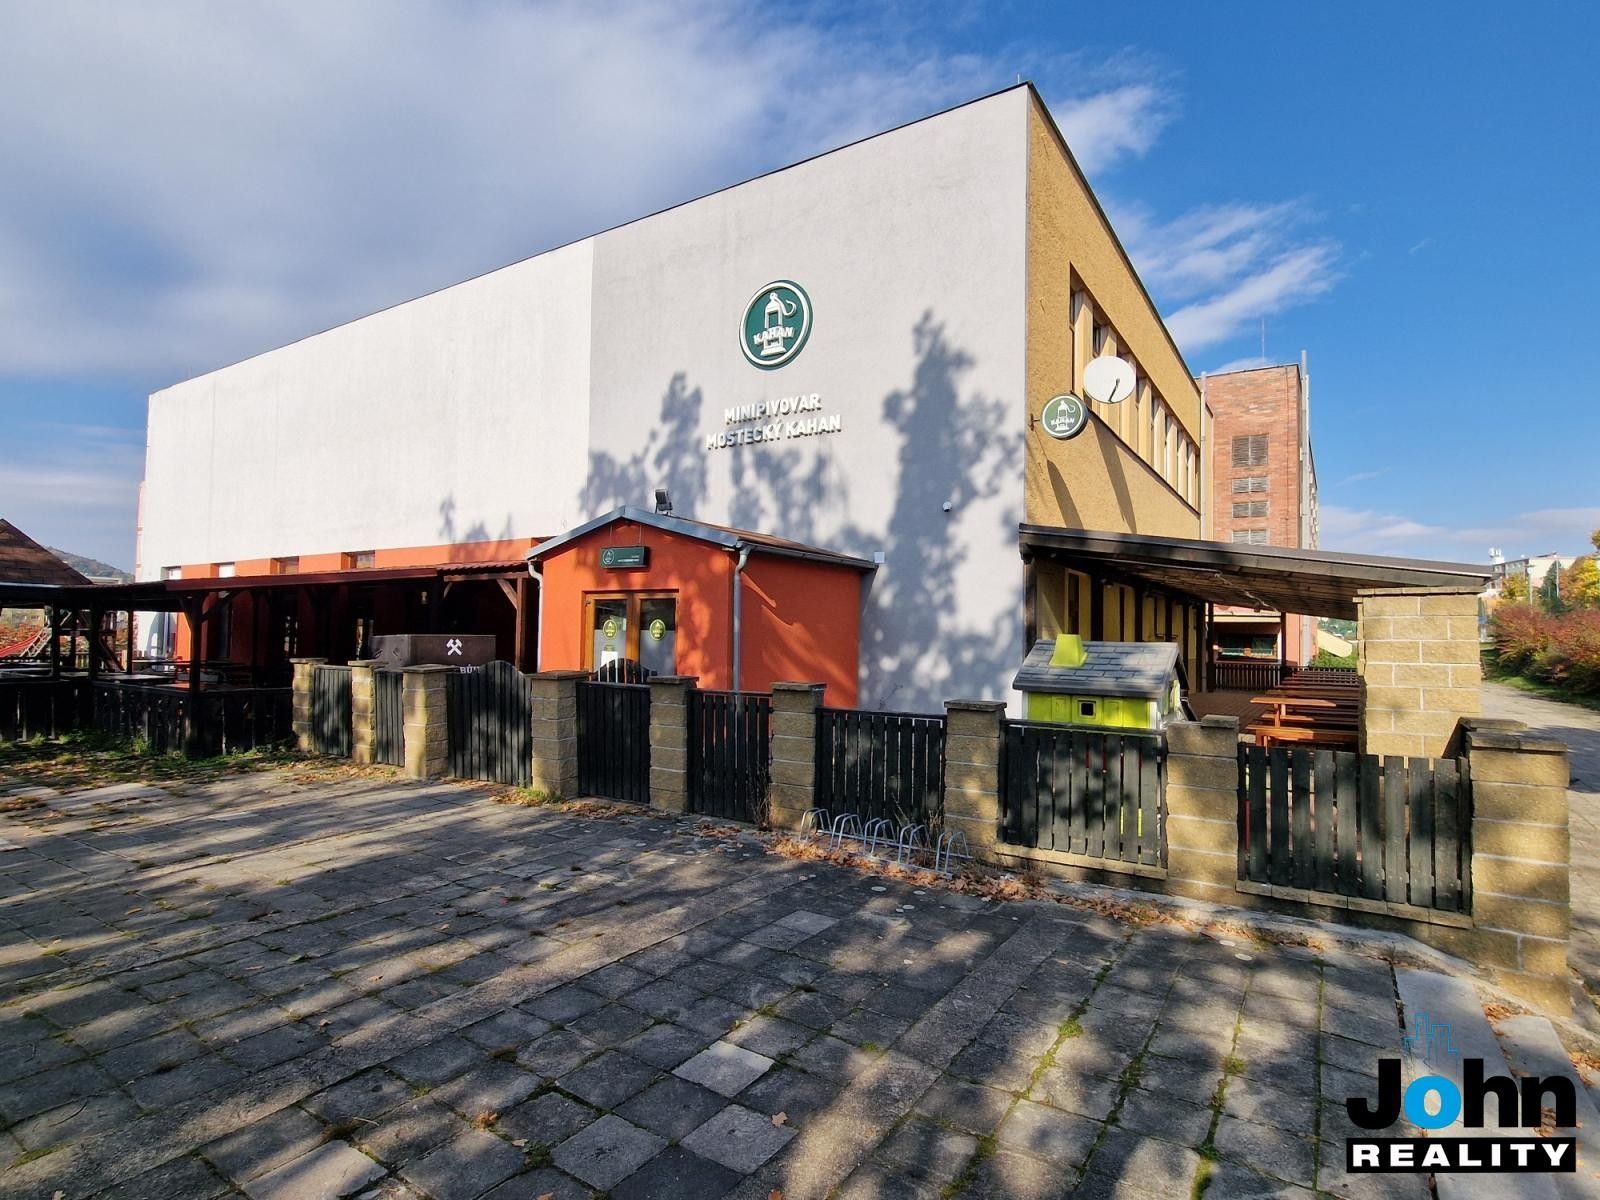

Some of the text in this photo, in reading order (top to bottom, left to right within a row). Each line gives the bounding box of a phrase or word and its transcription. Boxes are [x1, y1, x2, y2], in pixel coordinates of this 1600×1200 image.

[753, 326, 795, 345] KAHAN
[724, 393, 823, 425] MINIPIVOVAR
[705, 415, 842, 450] MOSTECKÝ KAHAN
